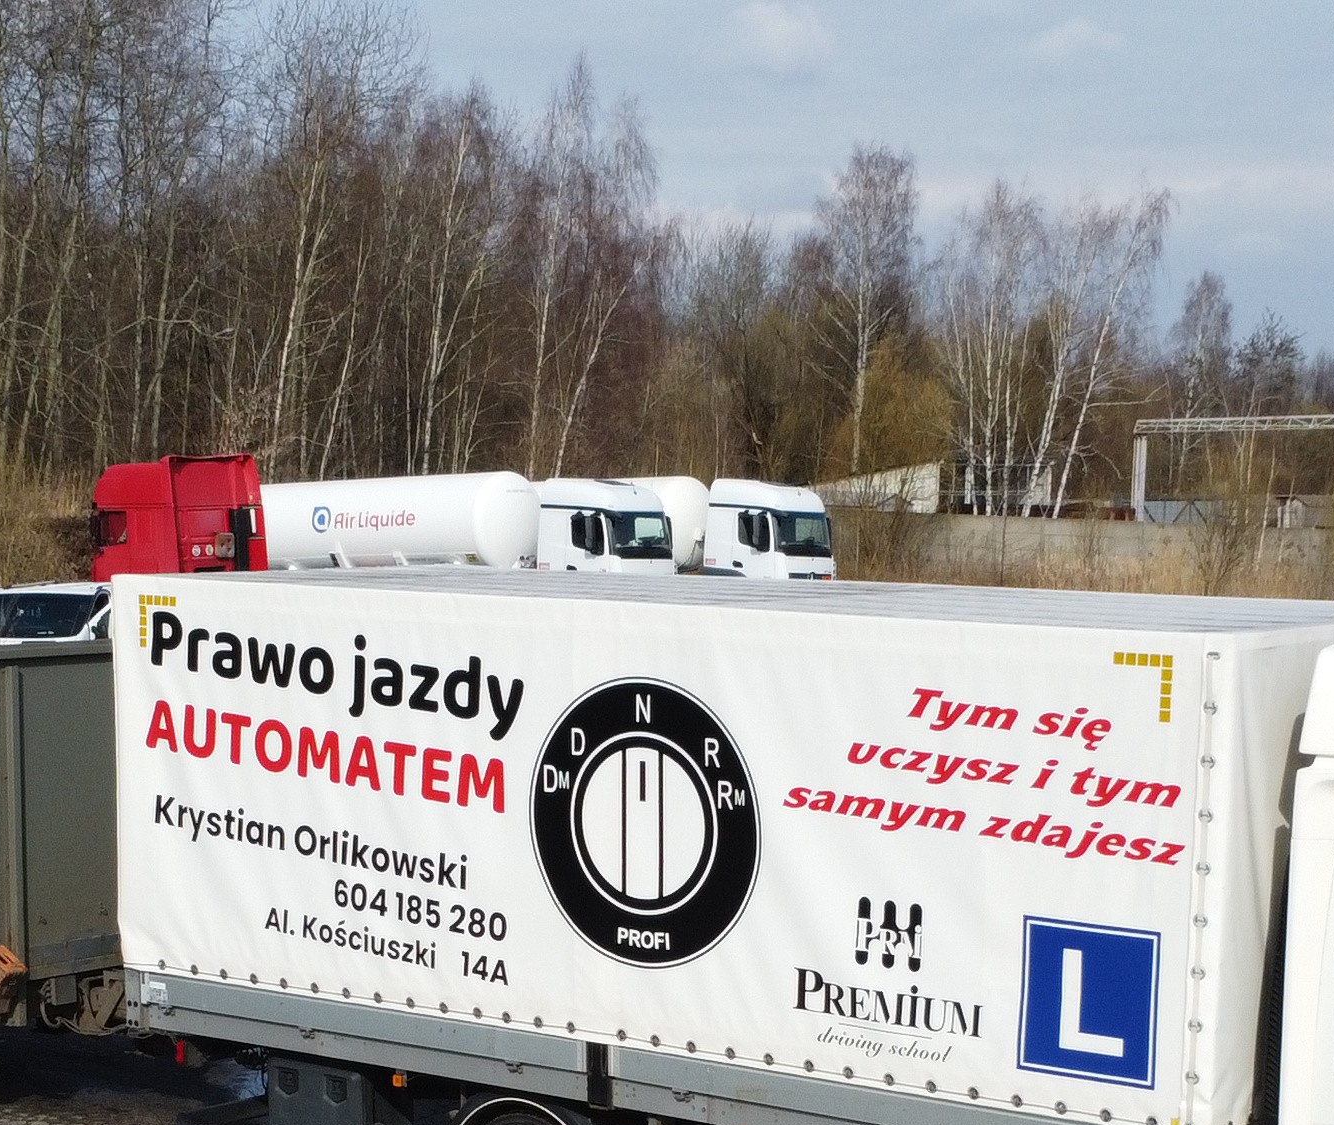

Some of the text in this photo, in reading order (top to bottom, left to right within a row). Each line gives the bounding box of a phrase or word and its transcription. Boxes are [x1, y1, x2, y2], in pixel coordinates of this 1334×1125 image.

[334, 509, 416, 531] Air Liquide
[150, 611, 525, 741] Prawo jazdy
[635, 693, 651, 723] N
[571, 727, 586, 757] D
[906, 687, 1112, 751] Tym się
[145, 700, 505, 814] AUTOMATEM
[704, 737, 721, 769] R
[846, 742, 1182, 808] uczysz i tym
[154, 794, 468, 890] Krystian Orlikowski
[783, 785, 1185, 867] samym zdajesz
[334, 879, 507, 942] 604 185 280
[617, 926, 671, 951] PROFI
[264, 907, 509, 986] Al. Kościuszki 14A
[1058, 948, 1124, 1058] L
[817, 1026, 953, 1063] driving school
